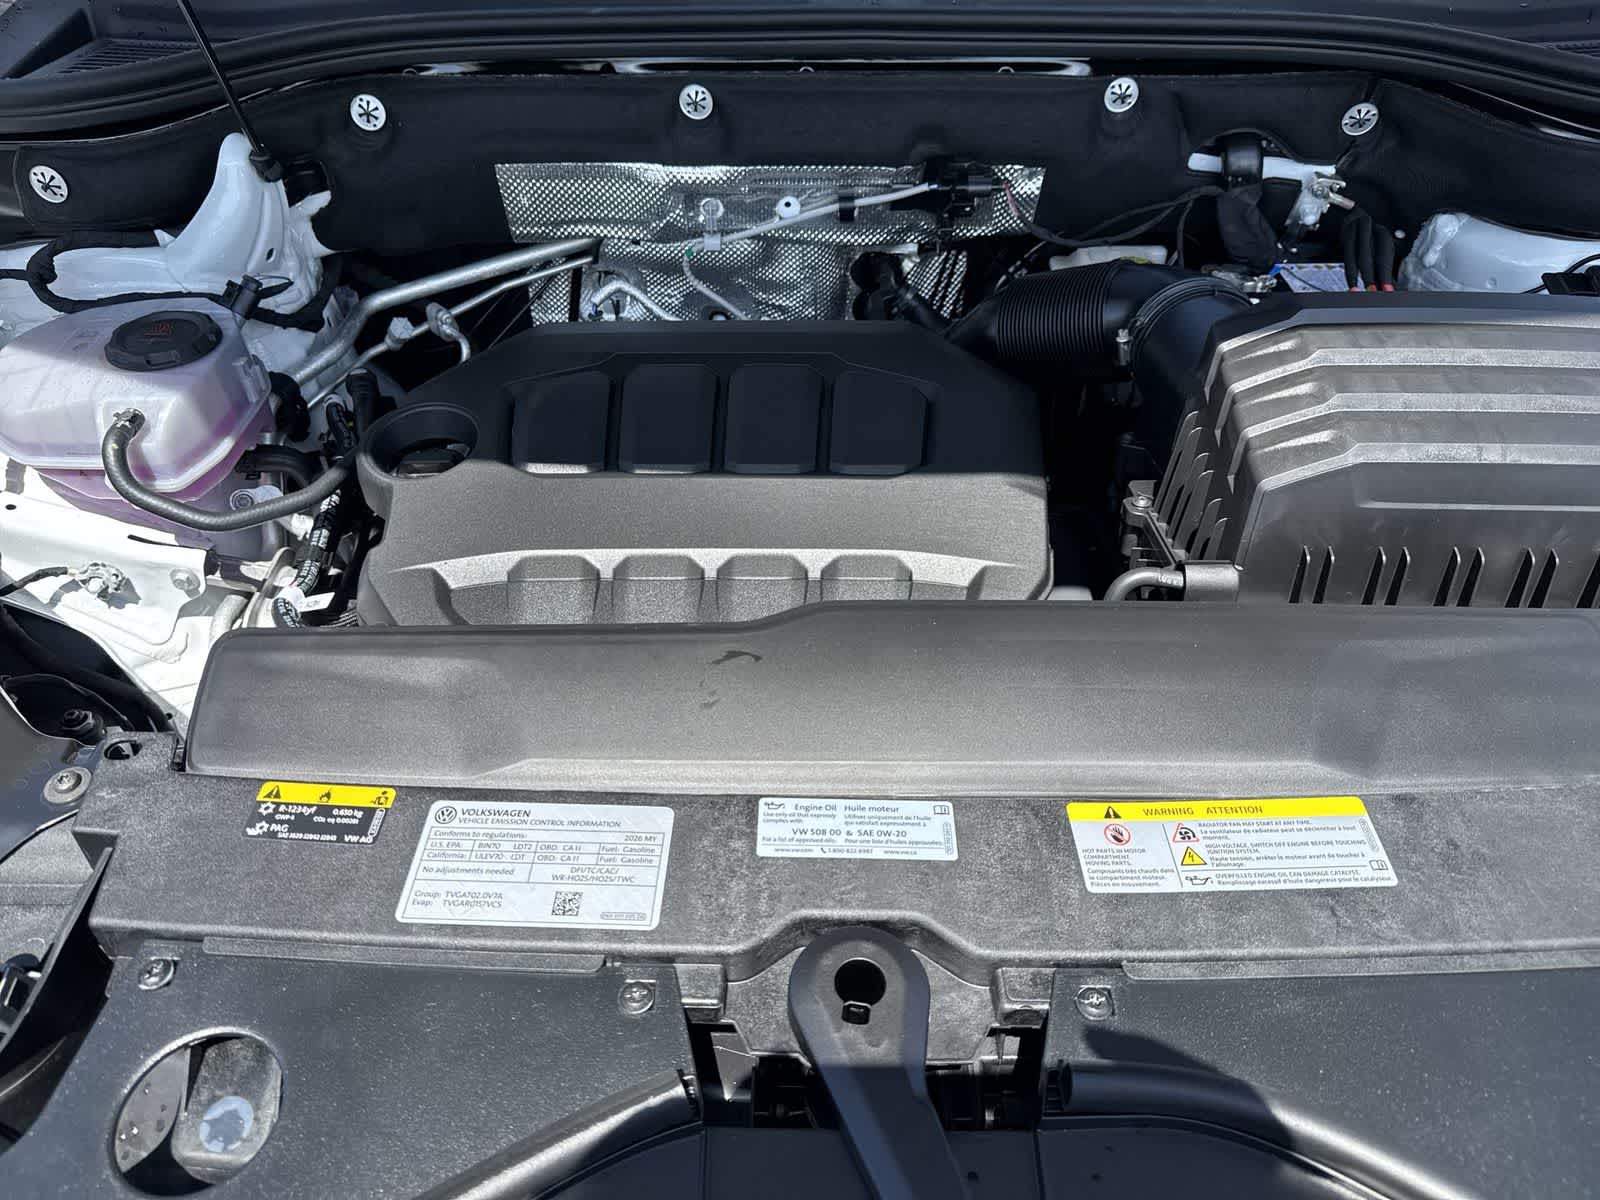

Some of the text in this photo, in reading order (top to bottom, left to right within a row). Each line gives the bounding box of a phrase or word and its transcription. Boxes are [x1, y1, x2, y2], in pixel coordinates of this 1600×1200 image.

[461, 808, 531, 817] VOLKSWAGEN
[794, 804, 823, 812] Engine
[1142, 807, 1194, 816] WARNING
[1206, 806, 1263, 815] ATTENTION
[270, 823, 289, 832] PAG
[810, 828, 827, 836] 508
[482, 831, 527, 839] regulations:
[857, 829, 874, 837] SAE
[344, 834, 373, 843] VW AG
[435, 867, 484, 875] adjustments
[414, 890, 442, 899] Group:
